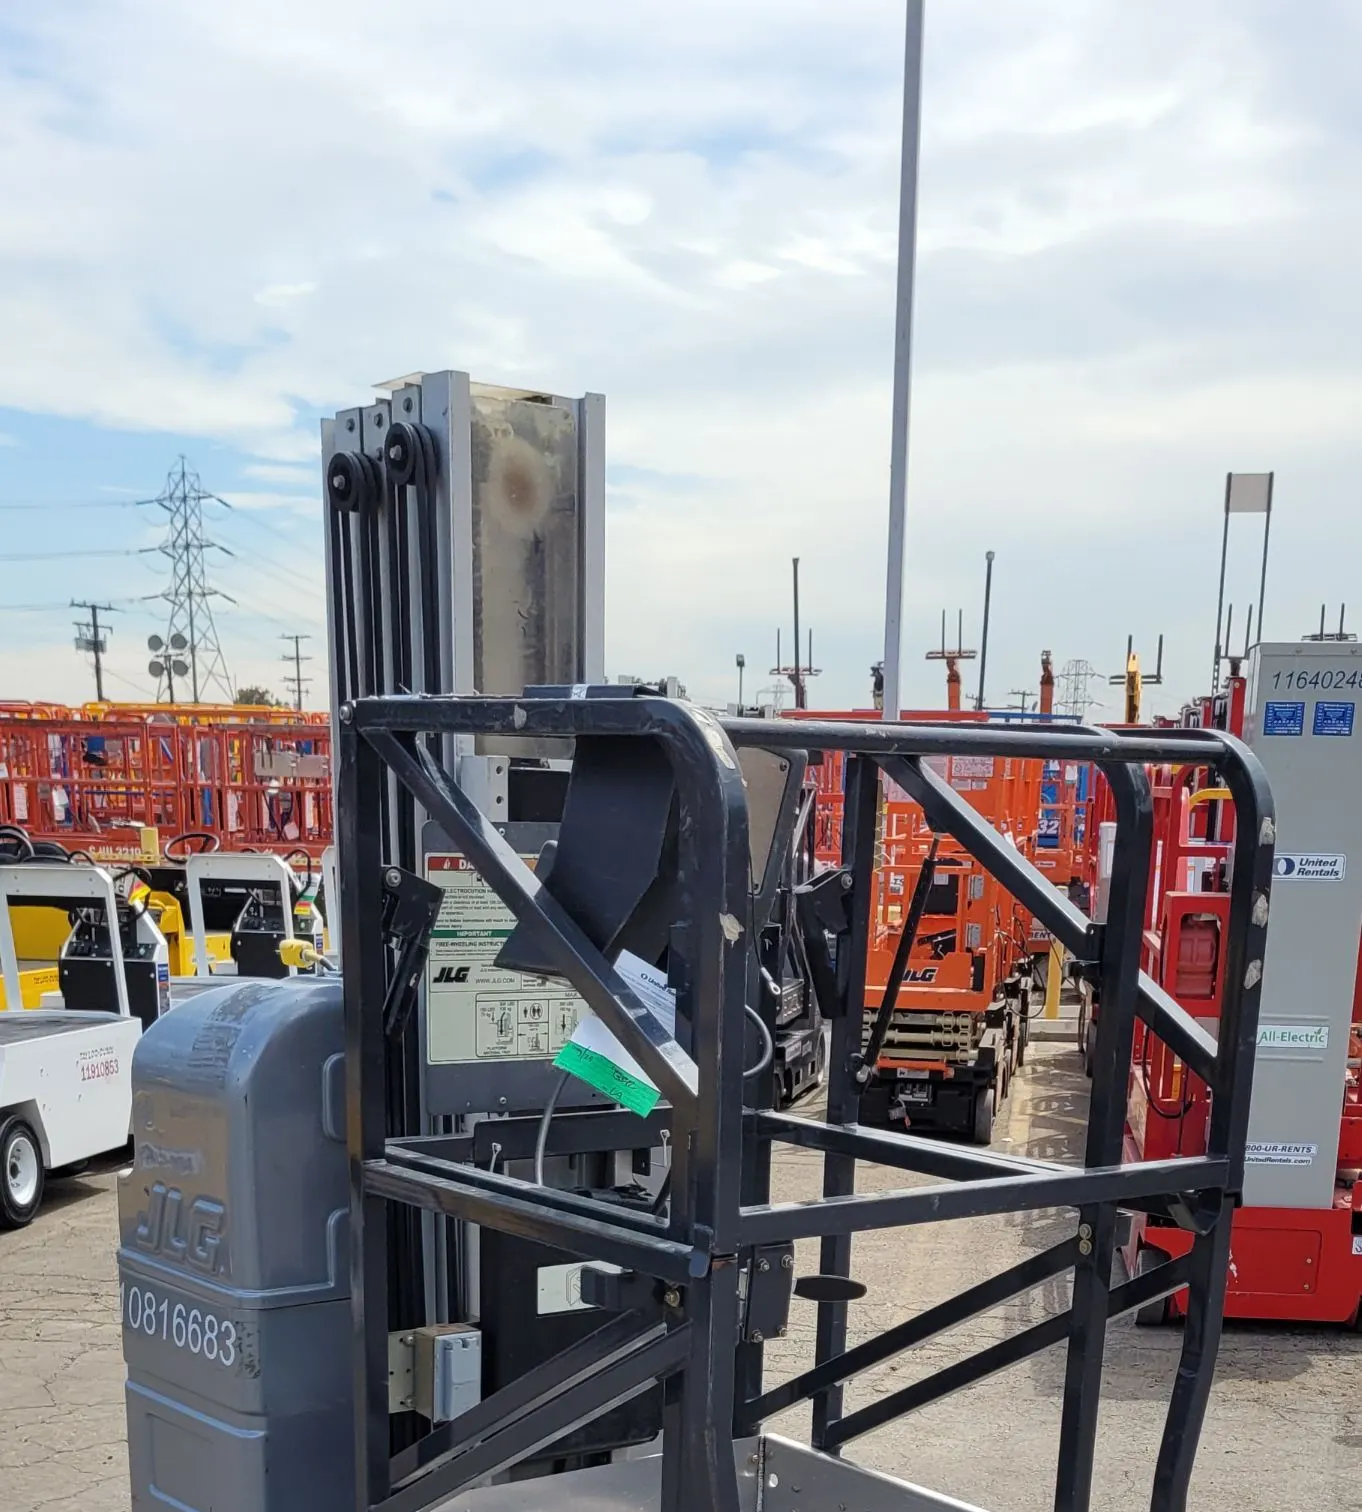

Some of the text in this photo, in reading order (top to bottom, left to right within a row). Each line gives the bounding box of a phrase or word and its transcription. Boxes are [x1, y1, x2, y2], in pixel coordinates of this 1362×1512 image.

[1038, 819, 1059, 834] 32
[1299, 858, 1338, 867] United
[1296, 867, 1340, 877] Rentals
[432, 966, 470, 984] JLG
[475, 976, 515, 984] WWW.JLG.COM
[1259, 1030, 1325, 1042] All-Electric
[81, 1059, 119, 1081] 11910853
[137, 1181, 225, 1266] JLG
